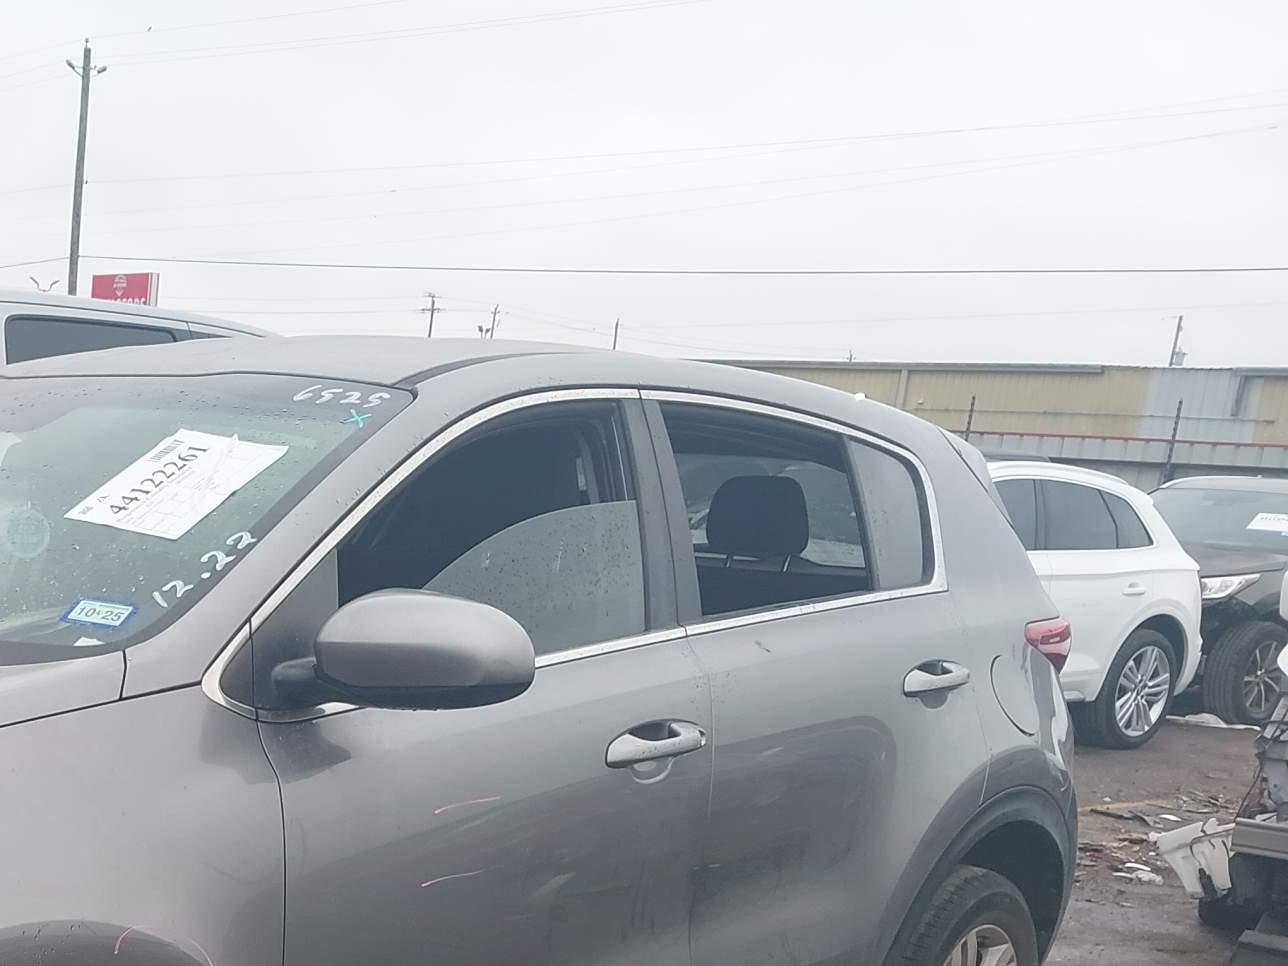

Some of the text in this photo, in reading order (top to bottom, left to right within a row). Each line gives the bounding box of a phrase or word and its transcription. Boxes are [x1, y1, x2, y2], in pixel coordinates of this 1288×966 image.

[293, 384, 391, 408] 6525
[108, 446, 209, 515] 44122261
[76, 606, 124, 622] 10 25
